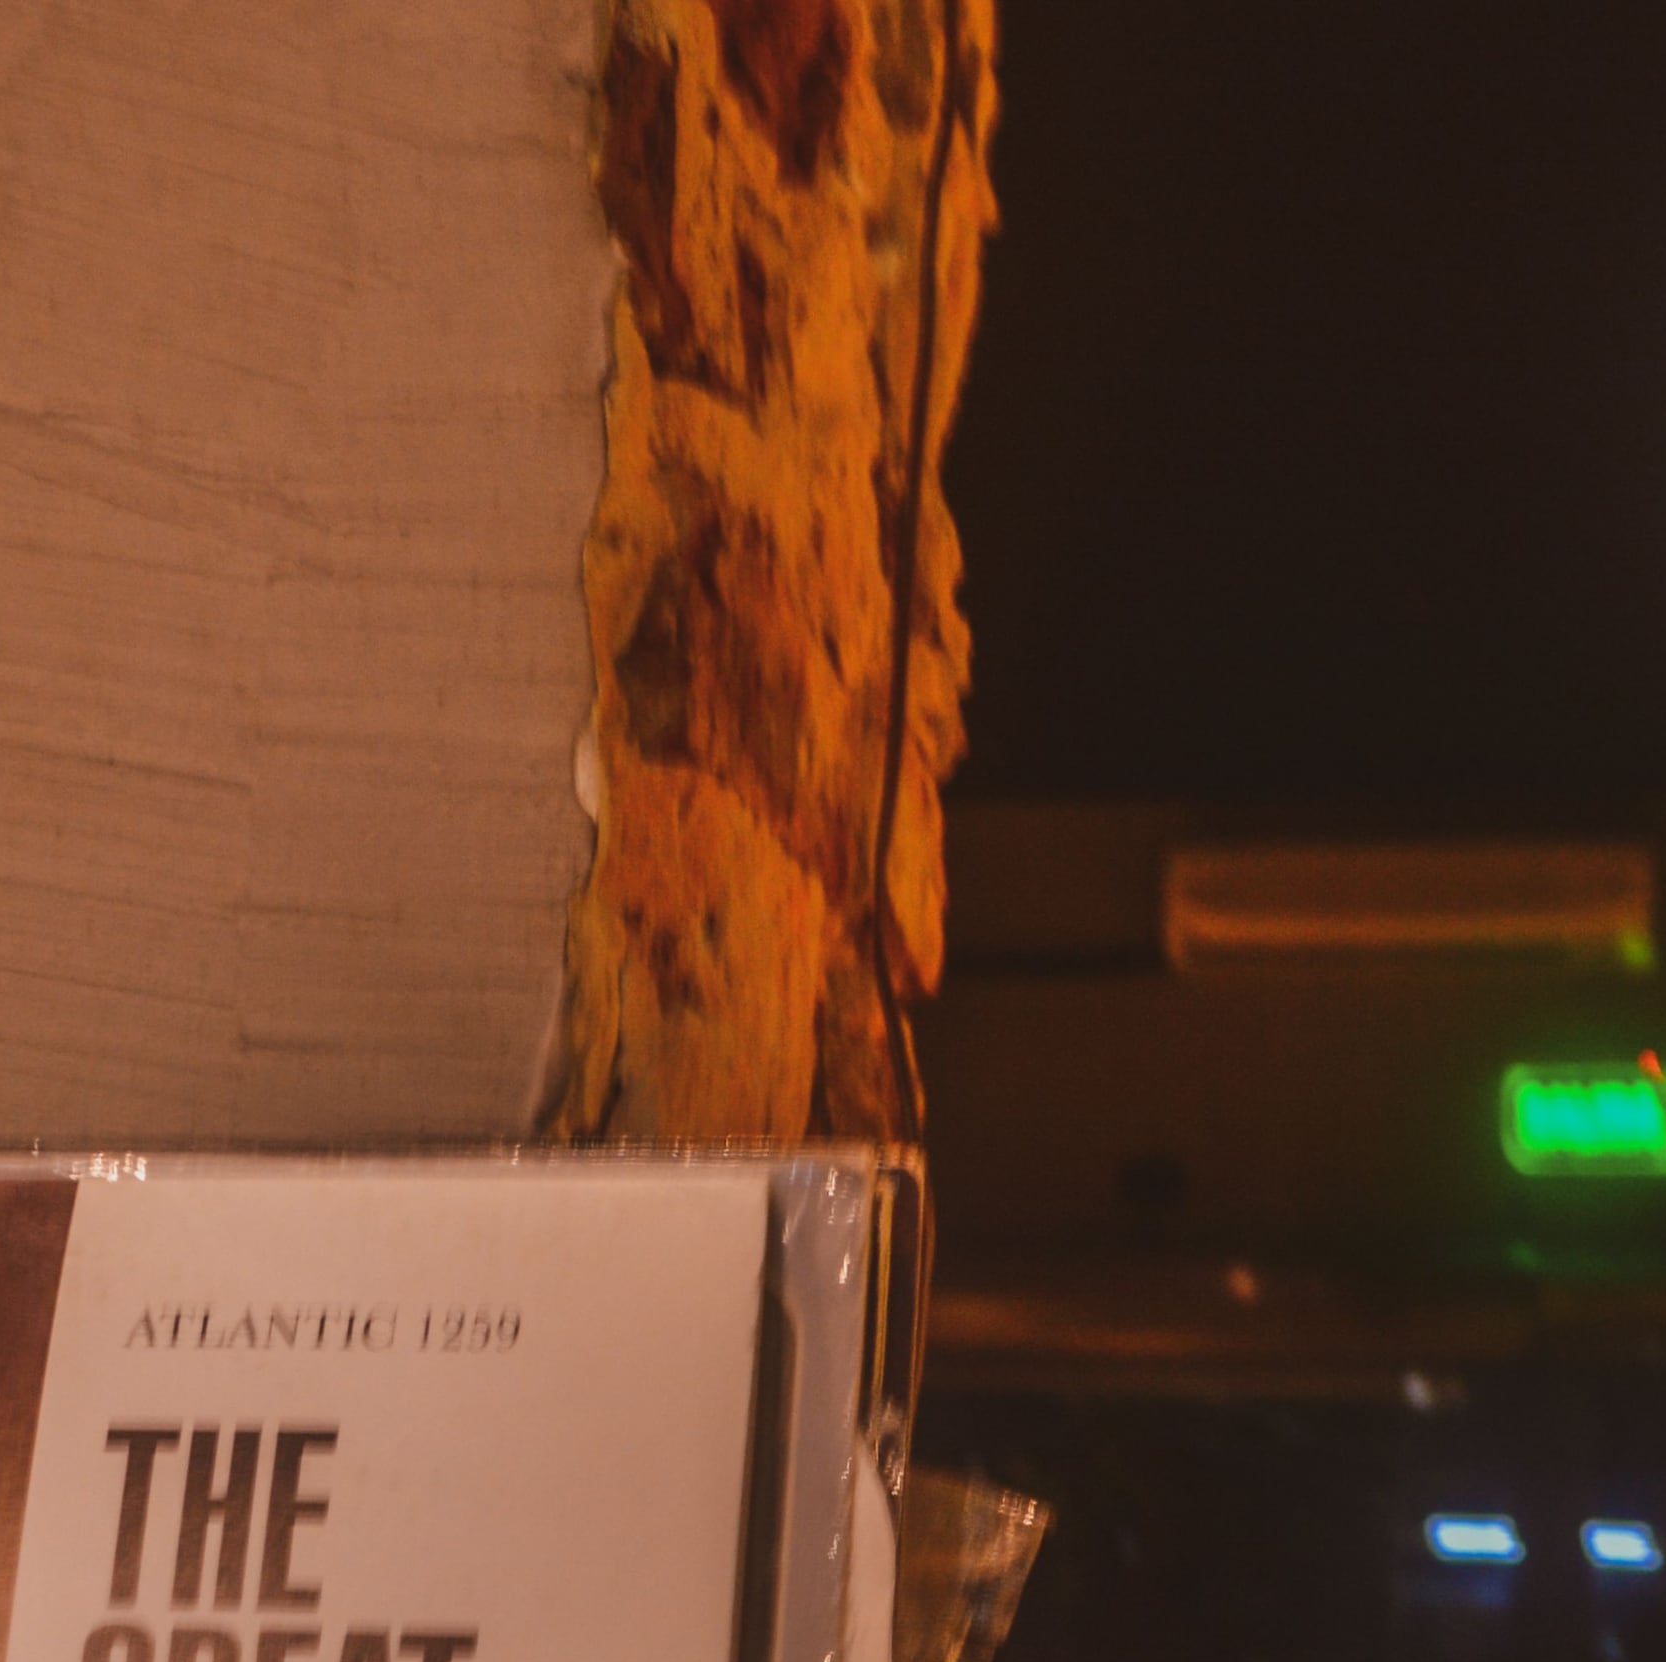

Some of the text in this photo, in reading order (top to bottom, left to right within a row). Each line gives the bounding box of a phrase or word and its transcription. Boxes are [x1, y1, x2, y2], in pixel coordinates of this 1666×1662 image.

[122, 1303, 523, 1355] ATLANTIC 1259
[103, 1422, 339, 1613] THE
